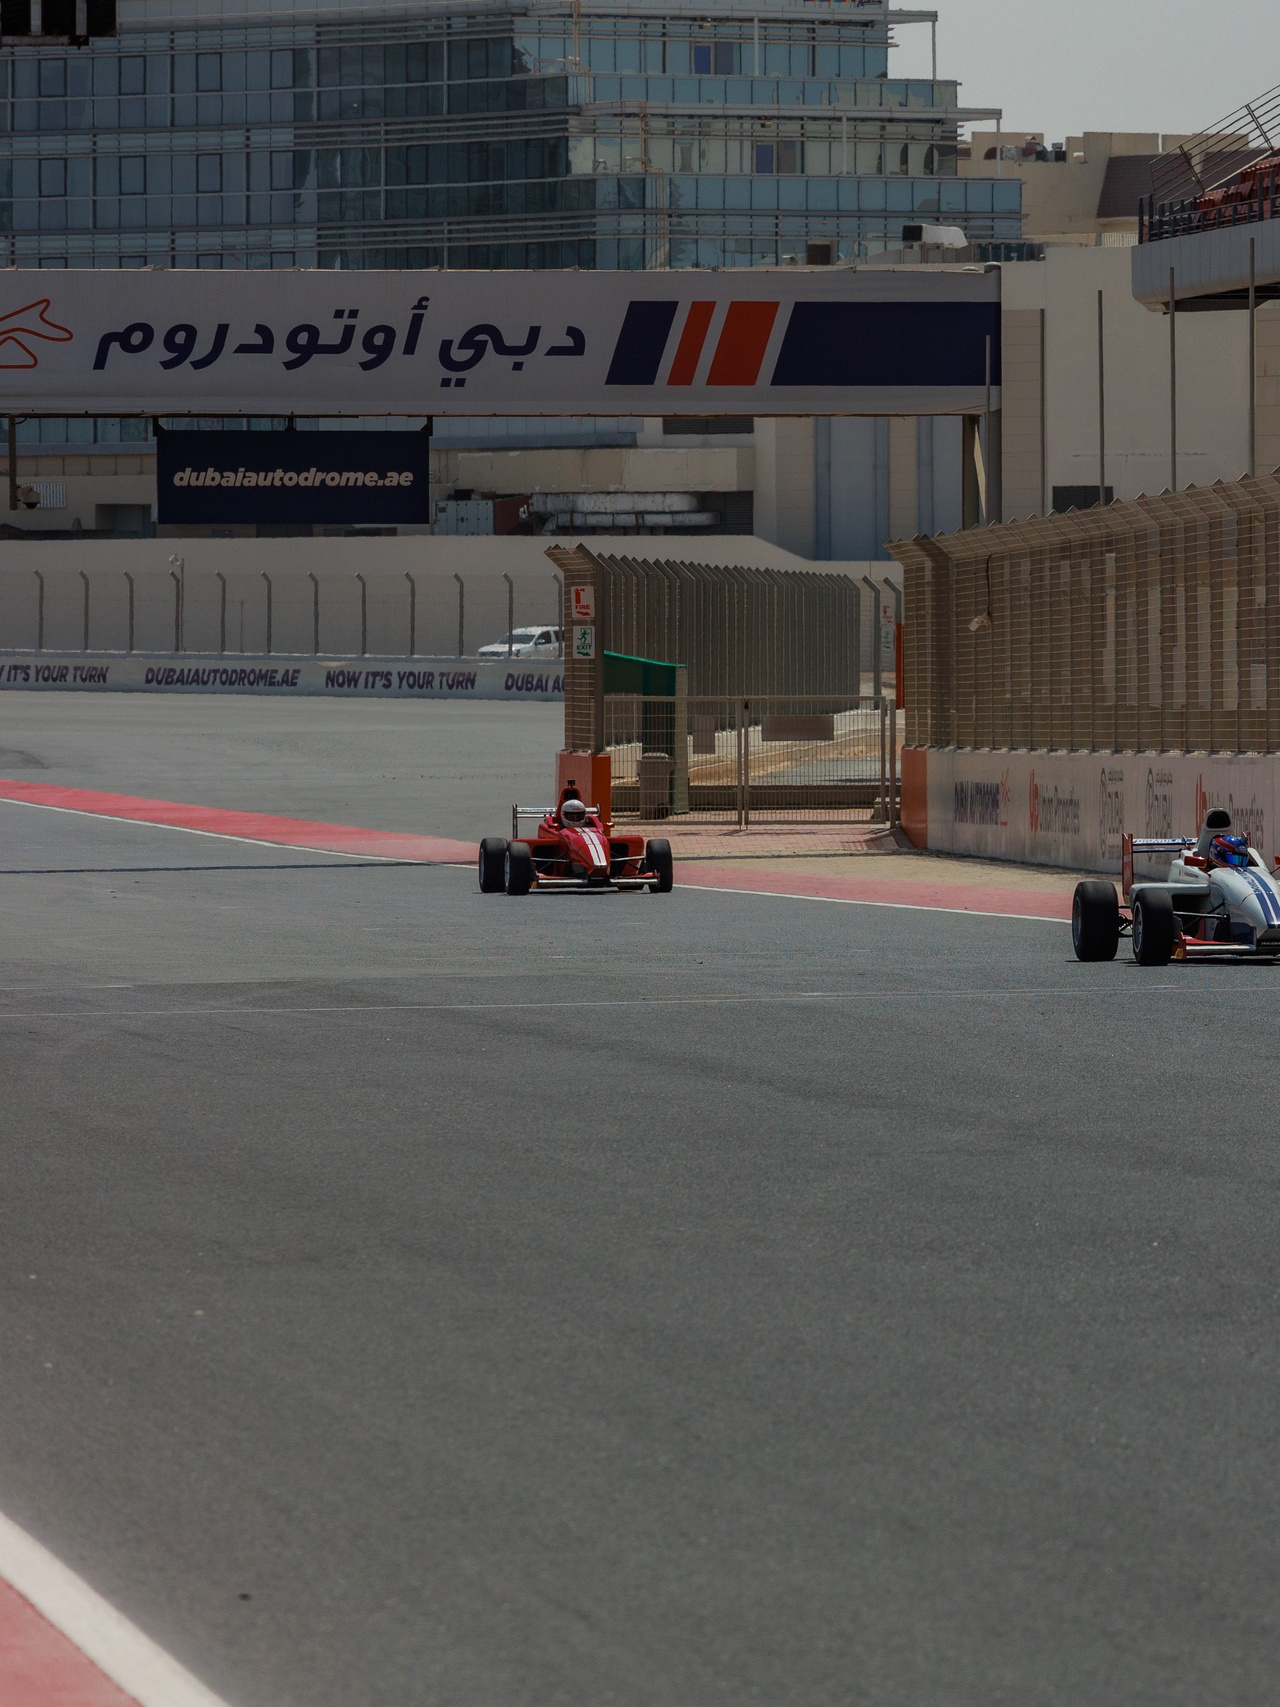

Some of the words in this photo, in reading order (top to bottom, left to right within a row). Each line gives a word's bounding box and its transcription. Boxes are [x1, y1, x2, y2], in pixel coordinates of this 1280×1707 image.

[93, 296, 430, 372] أوتودروم
[438, 324, 586, 388] دبي
[173, 467, 414, 488] dubaiautodrome.ae
[7, 664, 31, 682] IT'S
[34, 664, 69, 683] YOUR
[72, 665, 110, 684] TURN
[144, 667, 302, 688] DUBAIAUTODROME.AE
[325, 670, 362, 689] NOW
[363, 671, 392, 690] IT'S
[396, 671, 435, 690] YOUR
[439, 671, 476, 691] TURN
[504, 673, 550, 693] DUBAI
